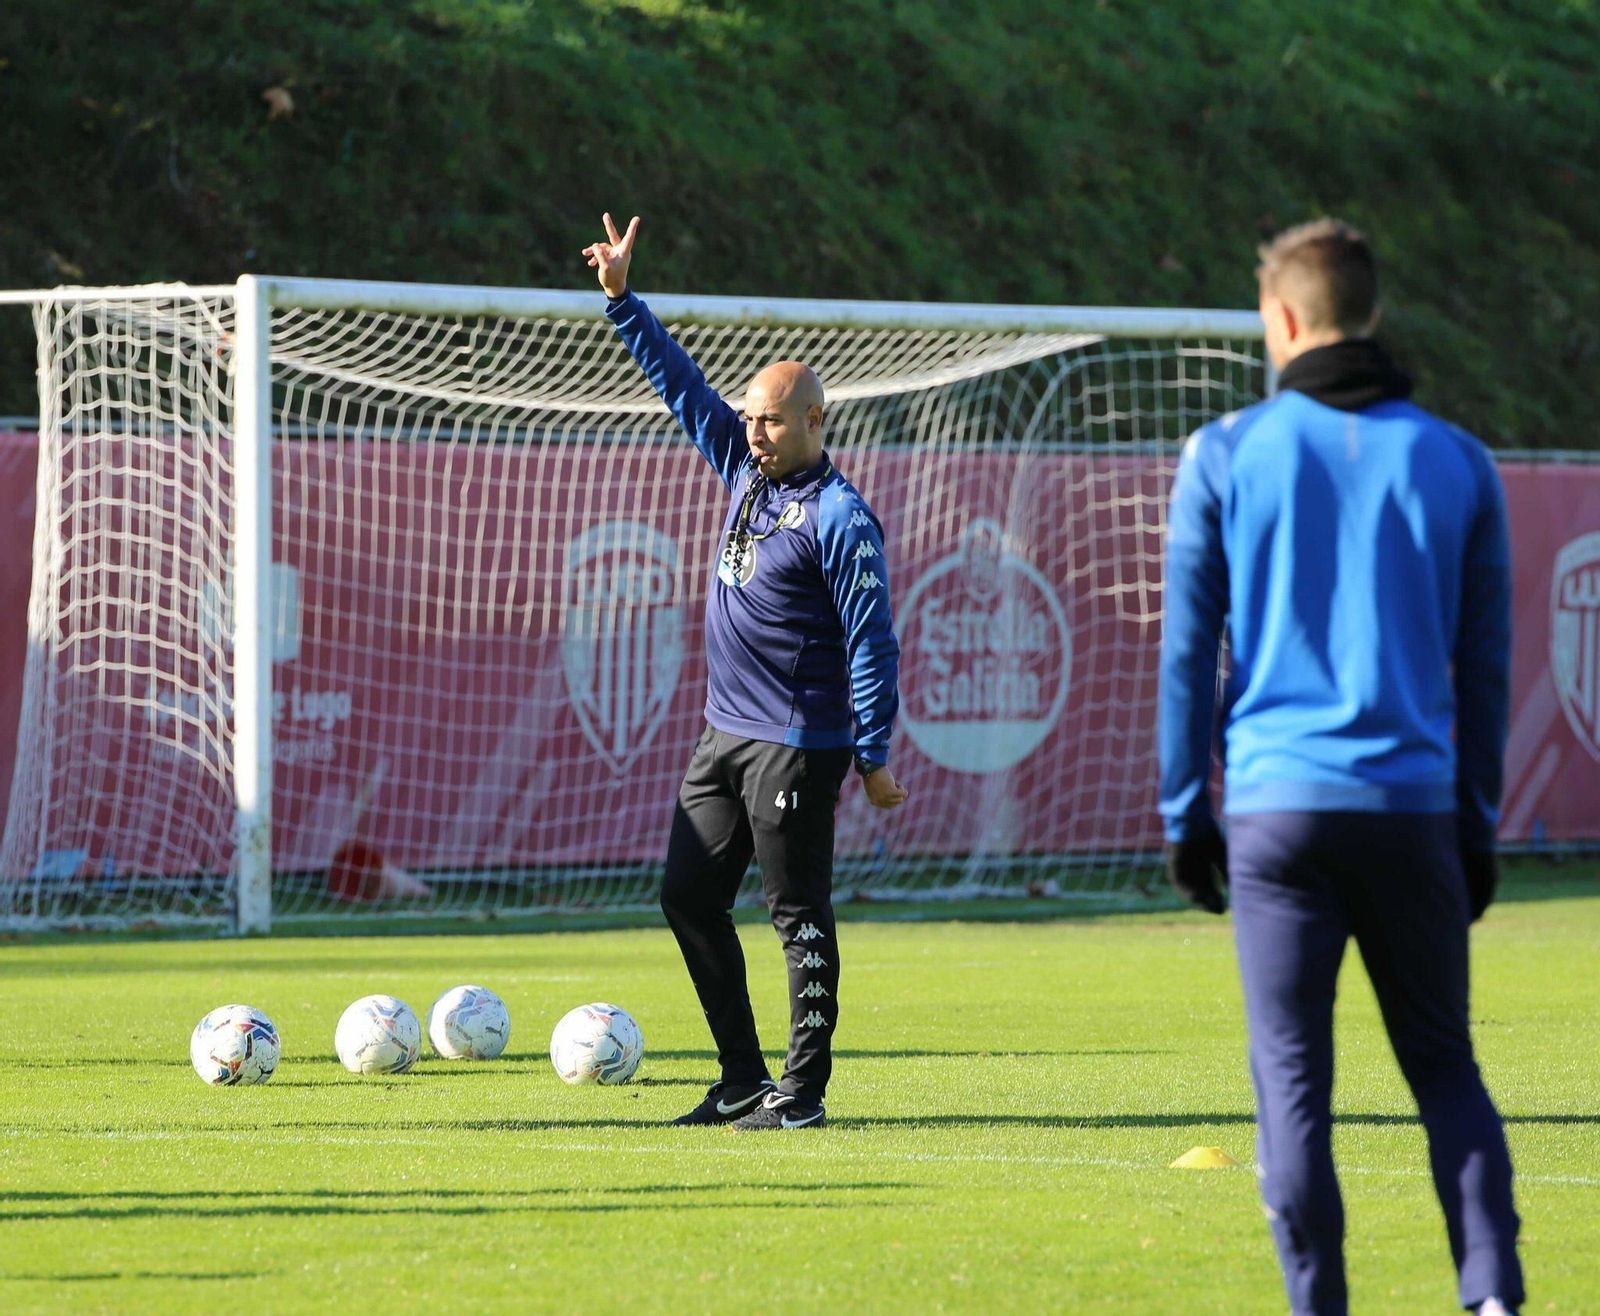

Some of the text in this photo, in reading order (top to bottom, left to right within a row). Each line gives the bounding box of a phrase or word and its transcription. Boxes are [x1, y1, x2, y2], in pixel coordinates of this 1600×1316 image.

[919, 597, 1048, 654] Estrella
[292, 684, 350, 730] Lugo
[922, 655, 1040, 716] Galicia
